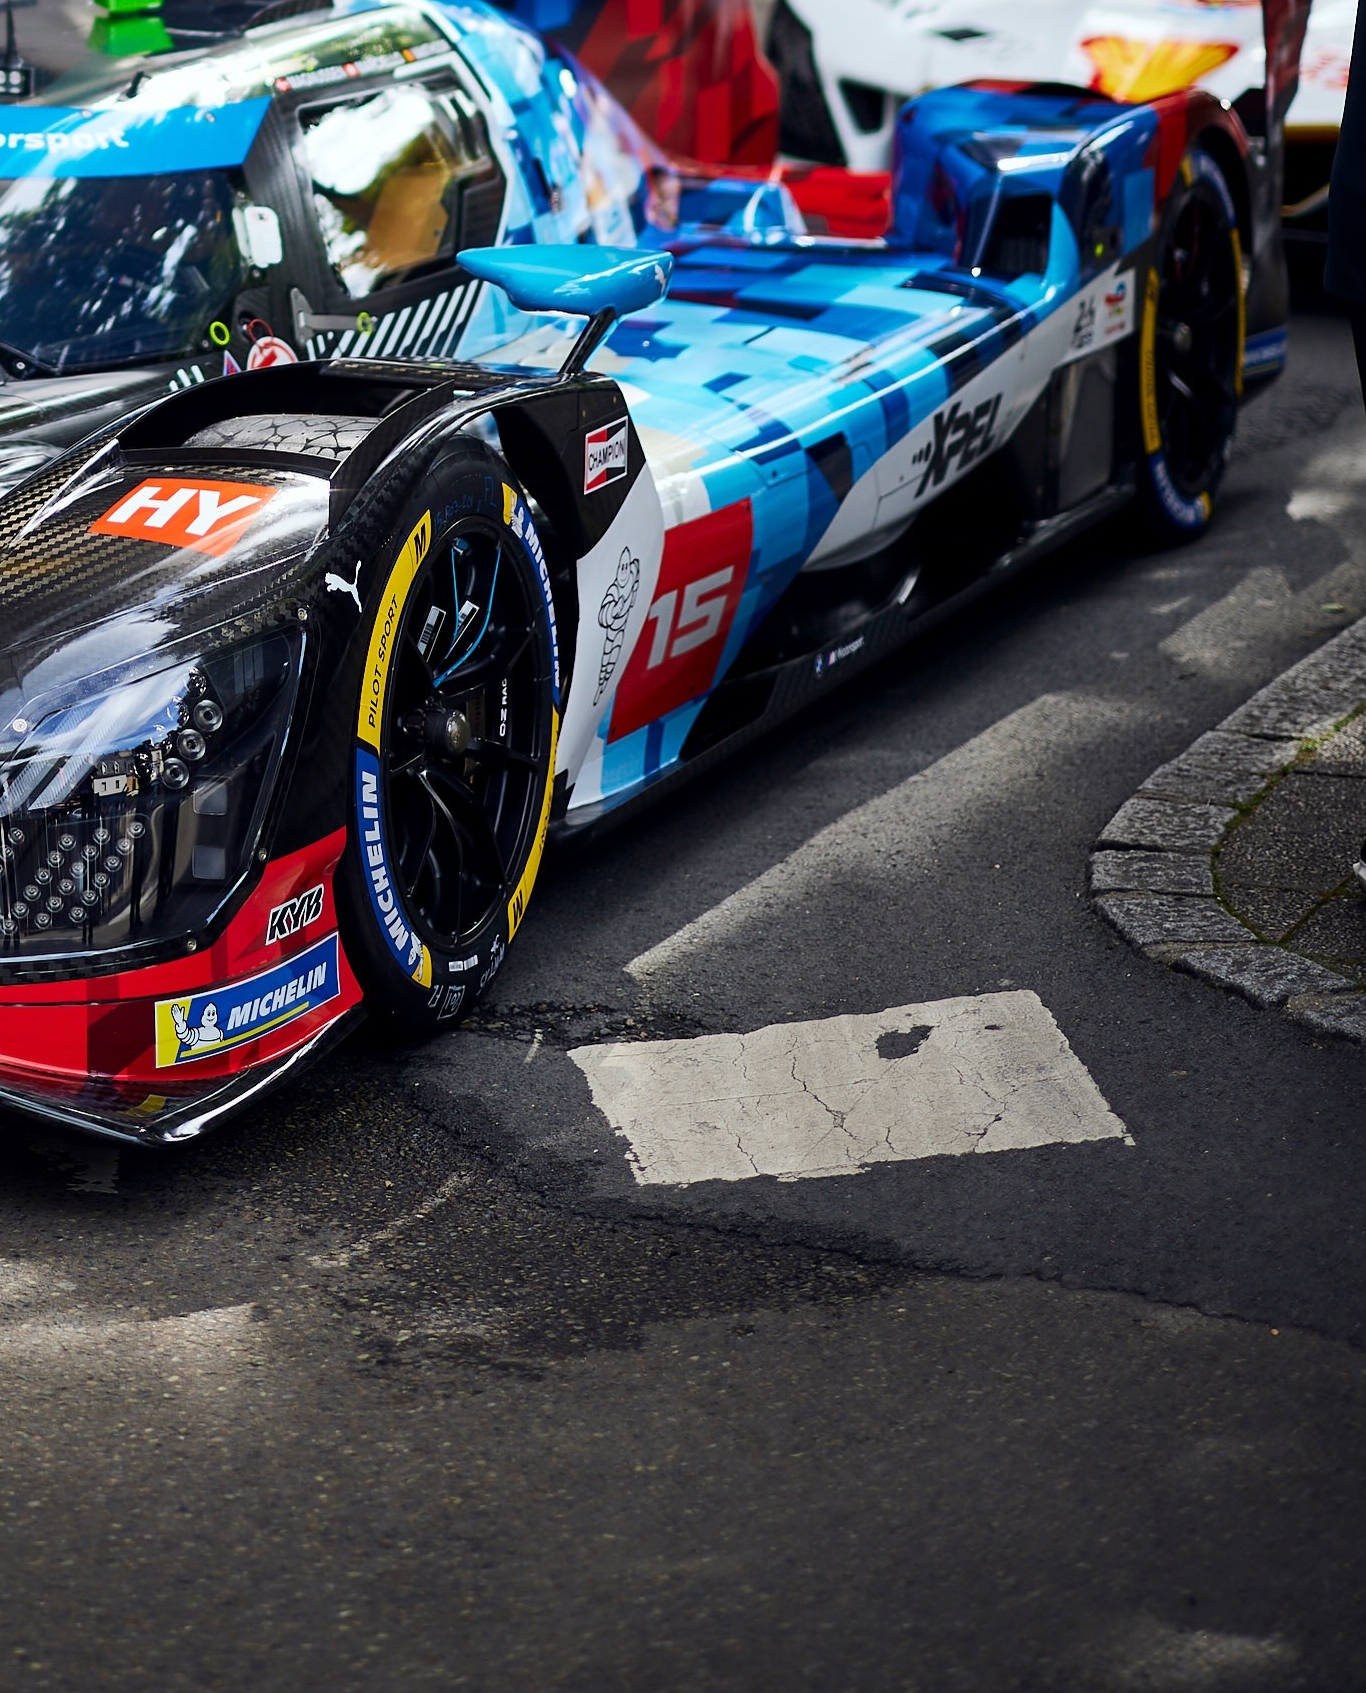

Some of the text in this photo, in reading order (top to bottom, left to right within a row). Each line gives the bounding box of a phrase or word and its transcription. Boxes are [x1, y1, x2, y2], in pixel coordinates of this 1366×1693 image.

[589, 439, 625, 471] CHAMPION
[106, 486, 262, 536] HY
[413, 522, 426, 566] M
[524, 521, 560, 689] MICHELIN
[647, 565, 735, 672] 15
[368, 593, 398, 729] PILOT SPORT
[361, 770, 409, 951] MICHELIN
[266, 883, 324, 946] KYB
[227, 961, 327, 1031] MICHELIN
